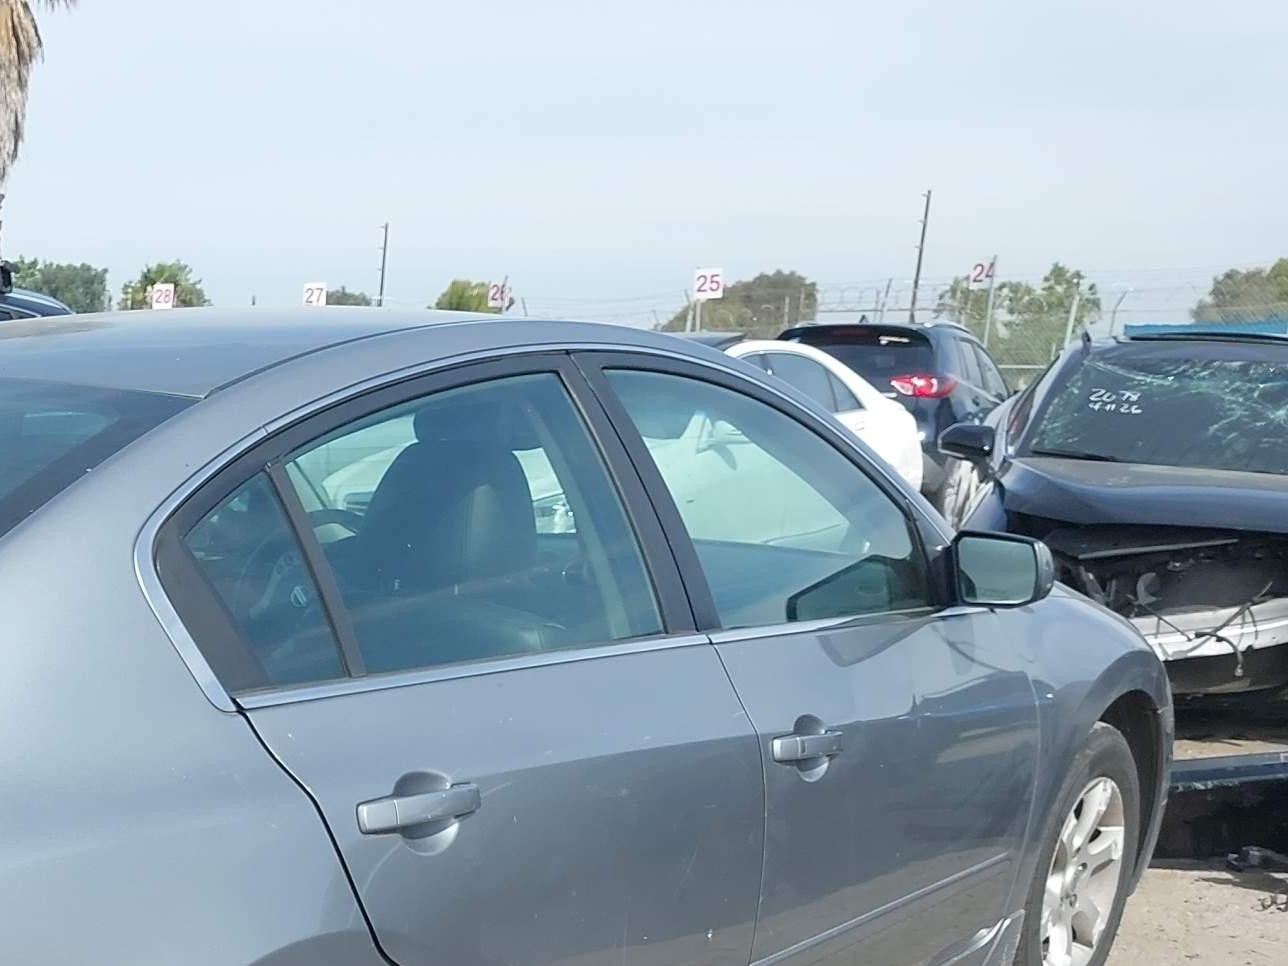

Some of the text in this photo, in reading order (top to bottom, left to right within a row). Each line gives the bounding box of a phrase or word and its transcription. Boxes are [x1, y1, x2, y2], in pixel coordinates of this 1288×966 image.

[696, 273, 721, 293] 25
[155, 289, 171, 304] 28
[305, 287, 324, 304] 27
